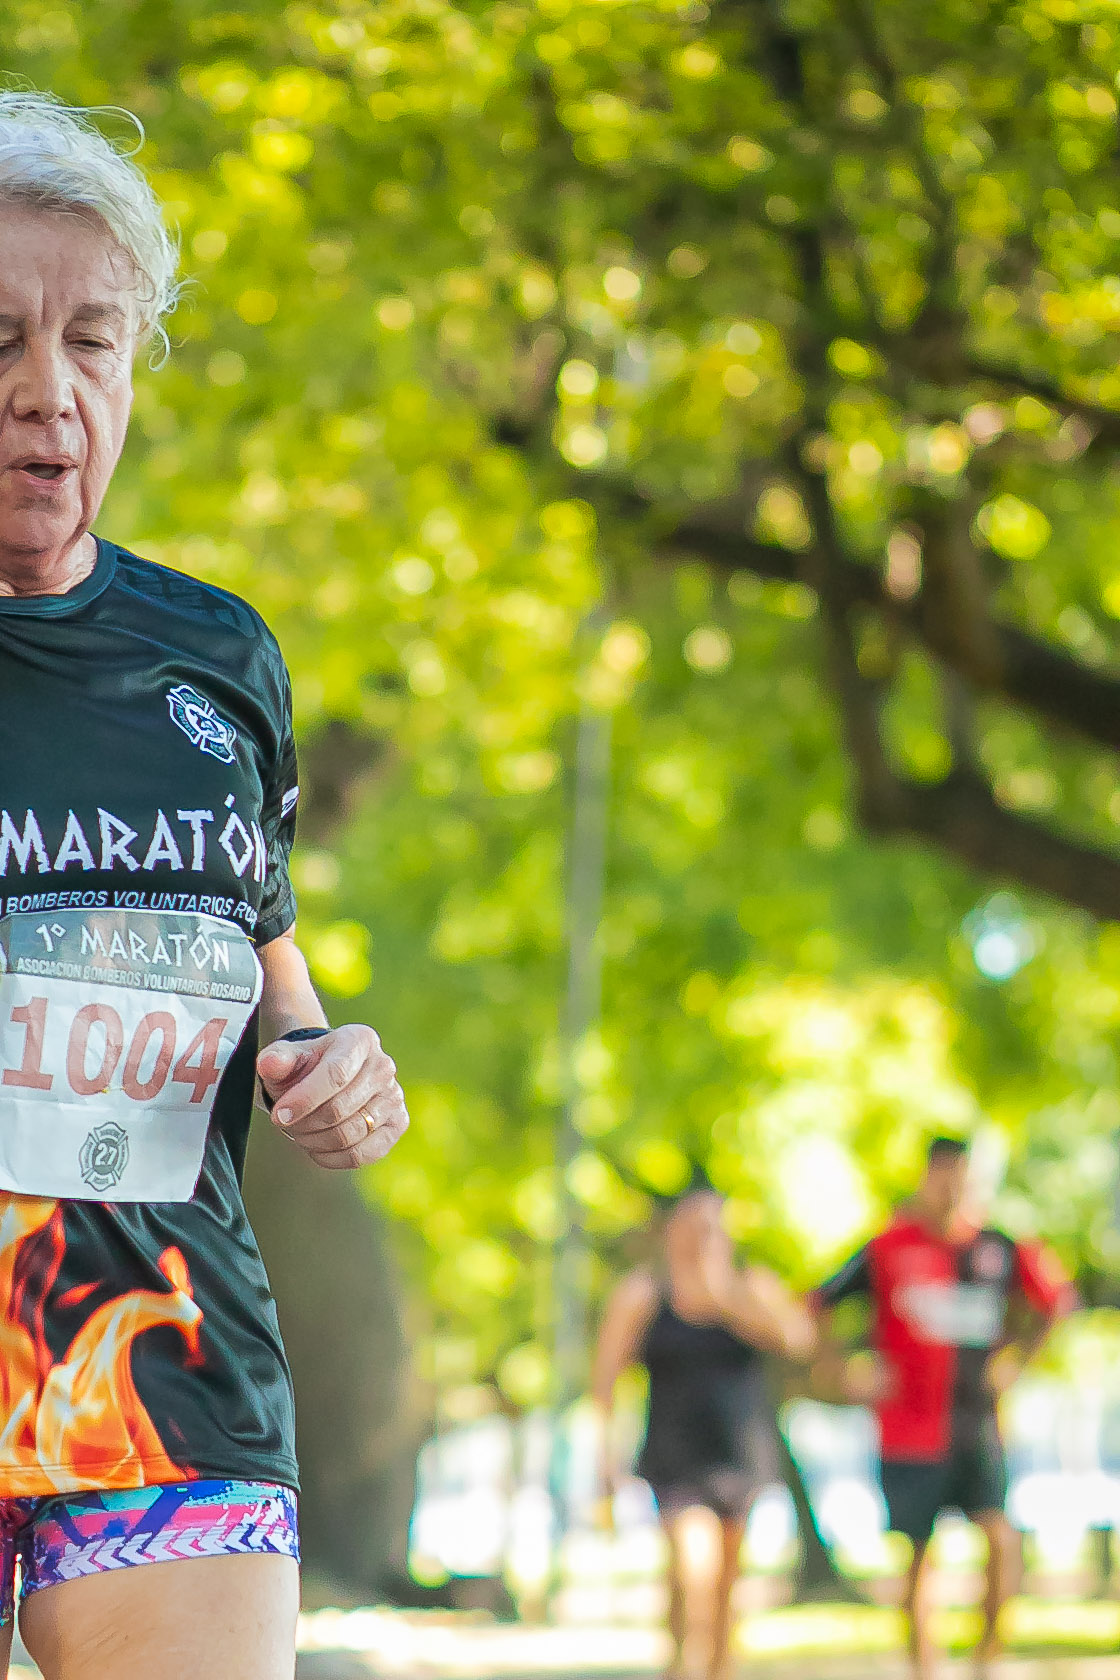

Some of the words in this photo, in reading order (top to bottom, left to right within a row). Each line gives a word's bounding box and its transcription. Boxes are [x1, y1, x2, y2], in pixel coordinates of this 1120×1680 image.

[5, 890, 109, 914] BOMBEROS
[113, 889, 236, 917] VOLUNTARIOS
[80, 923, 231, 974] MARATÓN
[83, 964, 142, 988] BOMBEROS
[144, 973, 211, 997] VOLUNTARIOS
[210, 980, 252, 1003] ROSARIO
[1, 996, 228, 1104] 1004
[94, 1142, 118, 1166] 27
